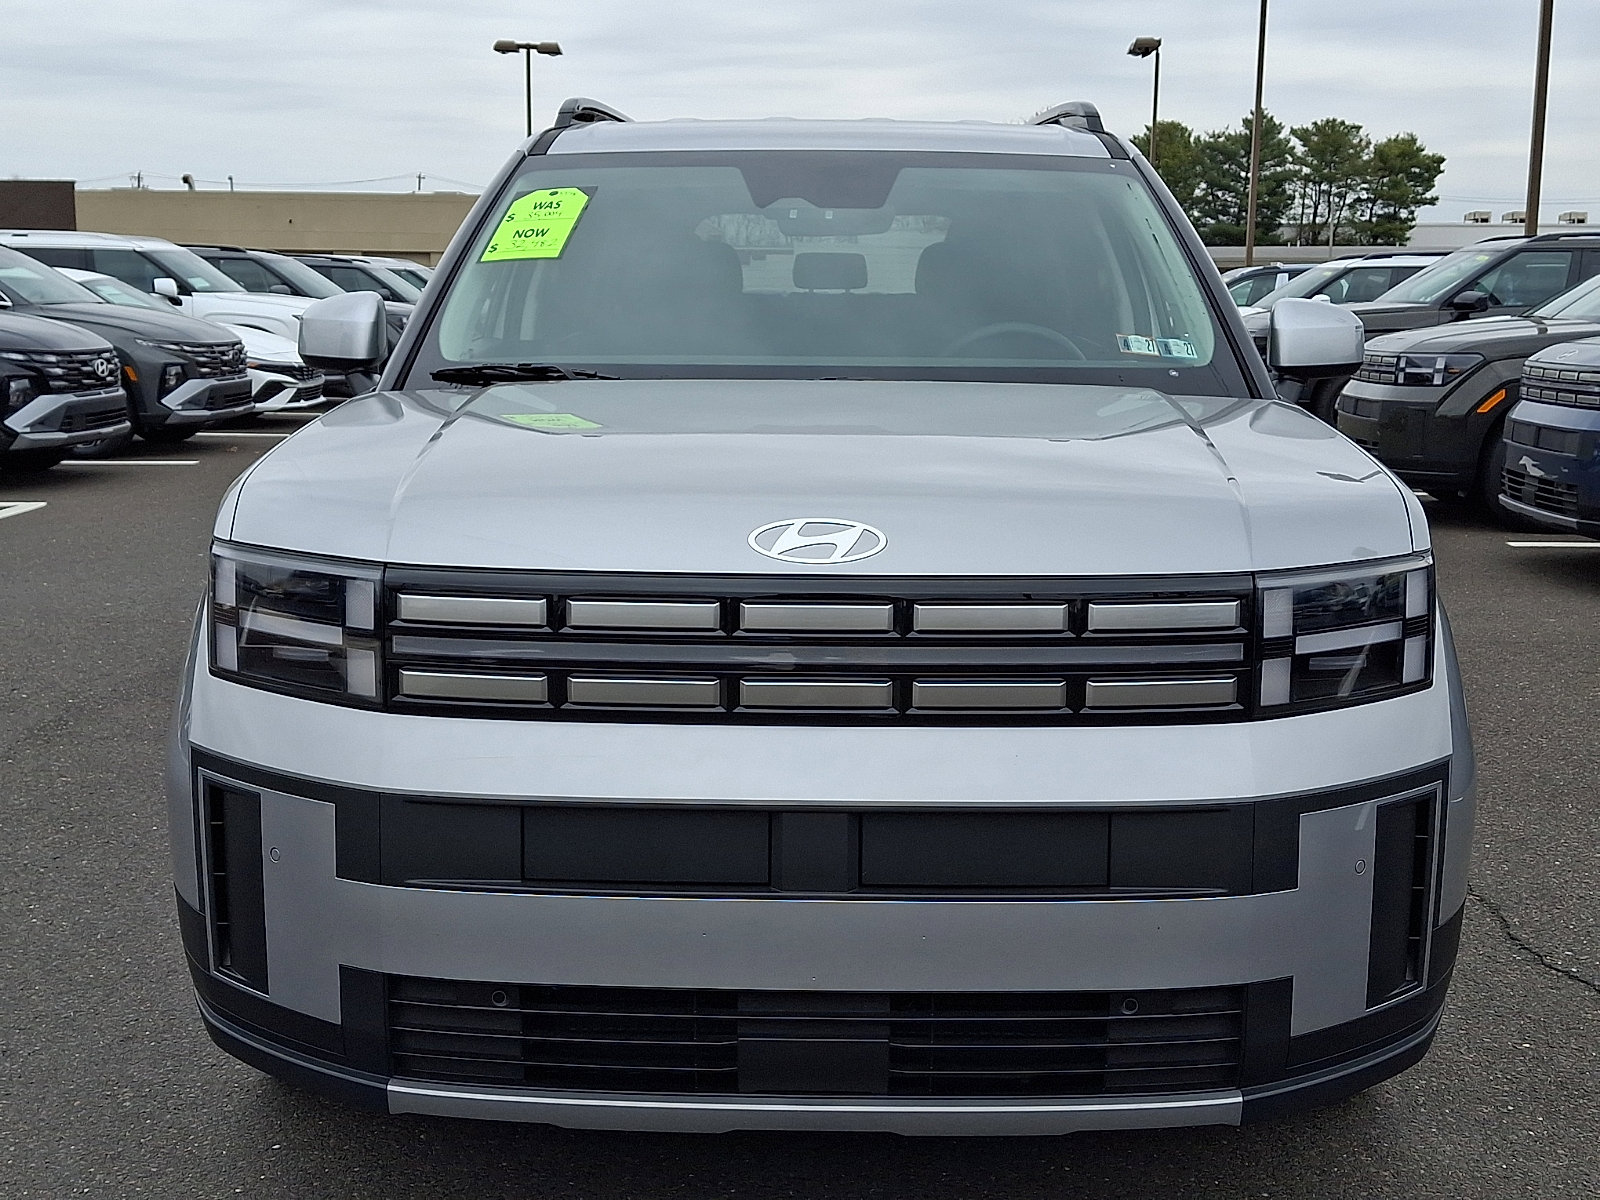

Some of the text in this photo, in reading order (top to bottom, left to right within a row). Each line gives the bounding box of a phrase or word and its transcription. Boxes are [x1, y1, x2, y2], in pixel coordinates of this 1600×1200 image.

[533, 200, 562, 210] WAS
[506, 213, 516, 222] $
[513, 228, 550, 239] NOW
[488, 243, 498, 253] $
